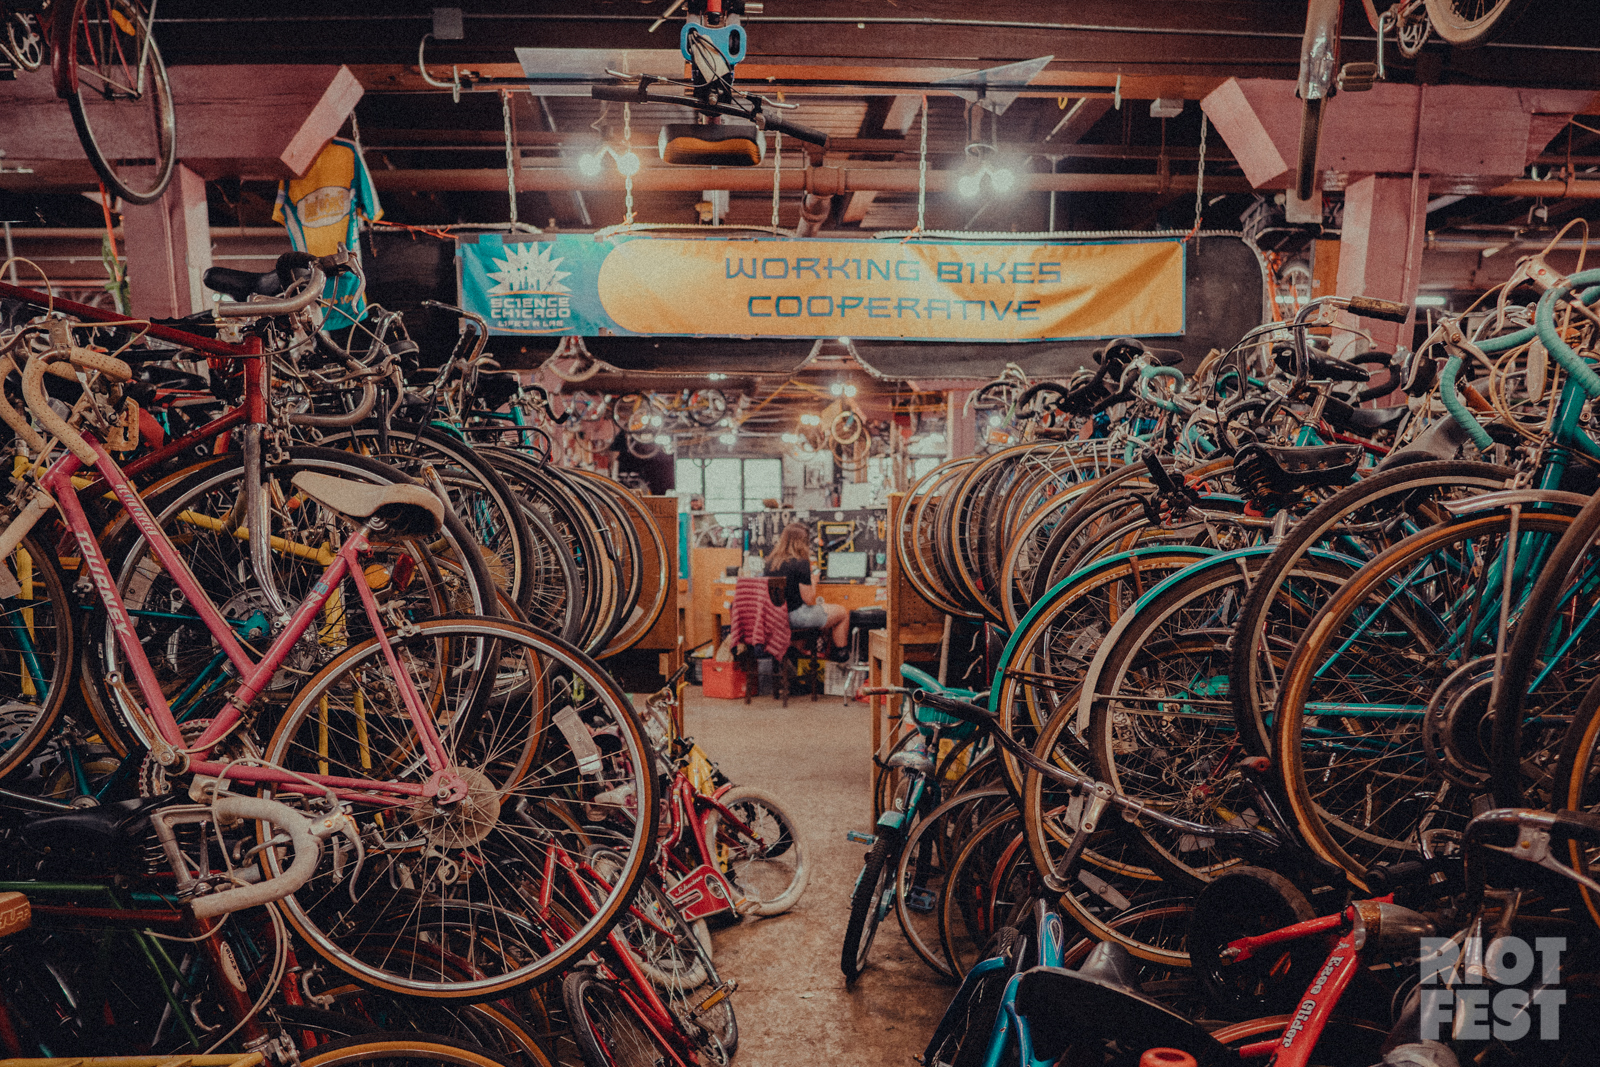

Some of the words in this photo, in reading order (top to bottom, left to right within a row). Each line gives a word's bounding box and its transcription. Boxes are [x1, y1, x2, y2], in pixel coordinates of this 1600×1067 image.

[725, 257, 921, 282] WORKING
[936, 261, 1063, 285] BIKES
[490, 297, 571, 308] SCIENCE
[490, 308, 571, 319] CHICAGO
[747, 295, 1042, 322] COOPERATIVE
[75, 529, 132, 638] TOURNEY
[1309, 955, 1345, 996] Ezee
[1281, 998, 1317, 1049] Glider
